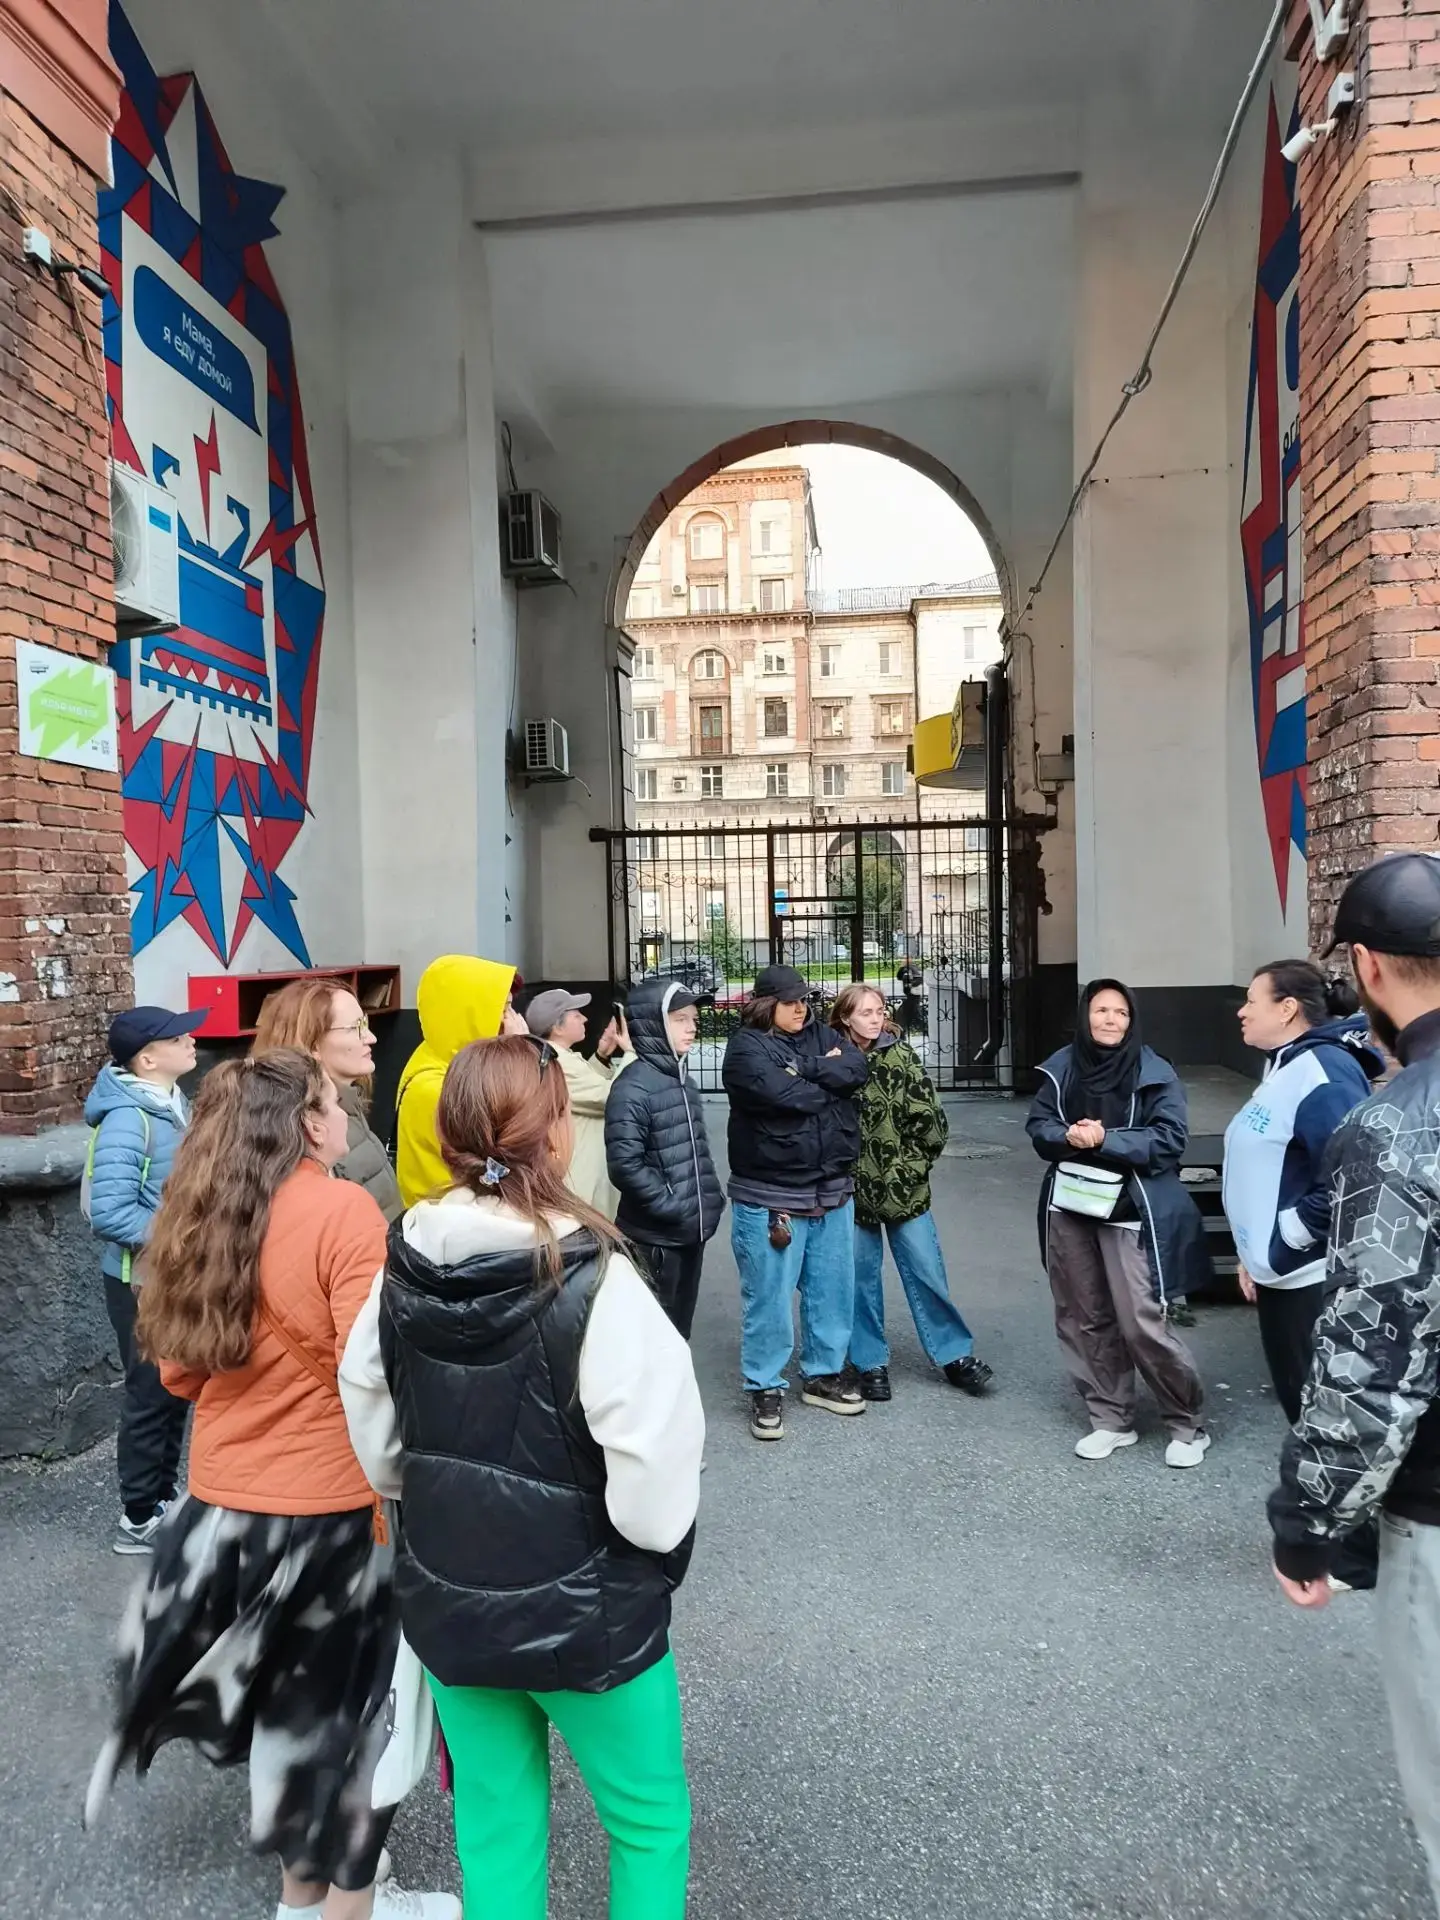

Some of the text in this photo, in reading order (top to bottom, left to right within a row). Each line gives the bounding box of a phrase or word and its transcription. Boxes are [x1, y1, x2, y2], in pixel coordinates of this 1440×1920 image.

[163, 325, 233, 394] я еду домой
[182, 311, 216, 361] Мама,
